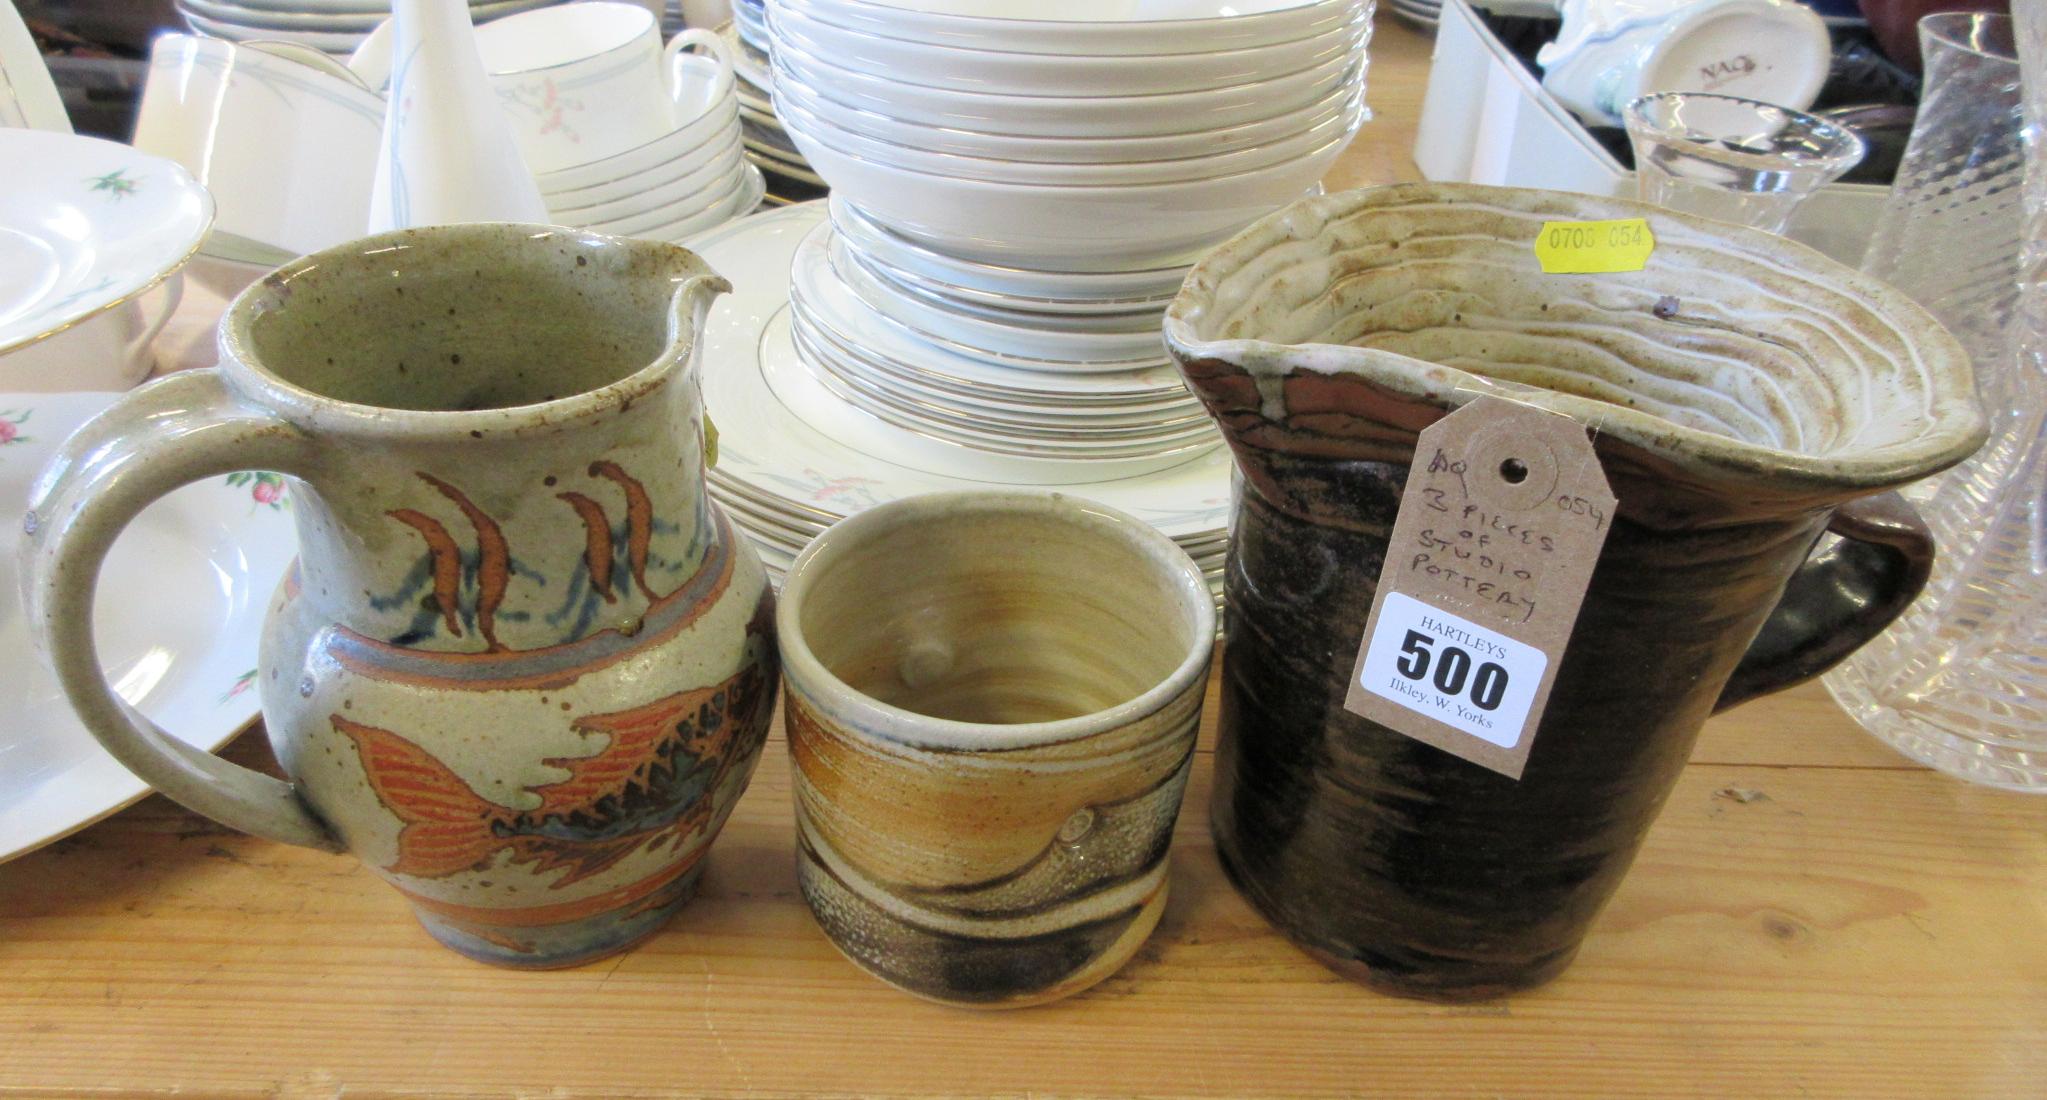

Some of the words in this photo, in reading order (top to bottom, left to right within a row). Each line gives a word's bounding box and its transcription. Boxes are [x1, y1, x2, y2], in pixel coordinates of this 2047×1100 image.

[1423, 488, 1448, 512] 3
[1464, 505, 1553, 552] PIECES
[1557, 495, 1605, 530] 054
[1418, 529, 1531, 579] STUDIO
[1459, 530, 1490, 547] OF
[1412, 553, 1536, 622] POTTERY
[1420, 616, 1507, 660] HARTLEYS
[1396, 628, 1509, 711] 500
[1436, 695, 1451, 713] W.
[1457, 704, 1494, 729] Yorks
